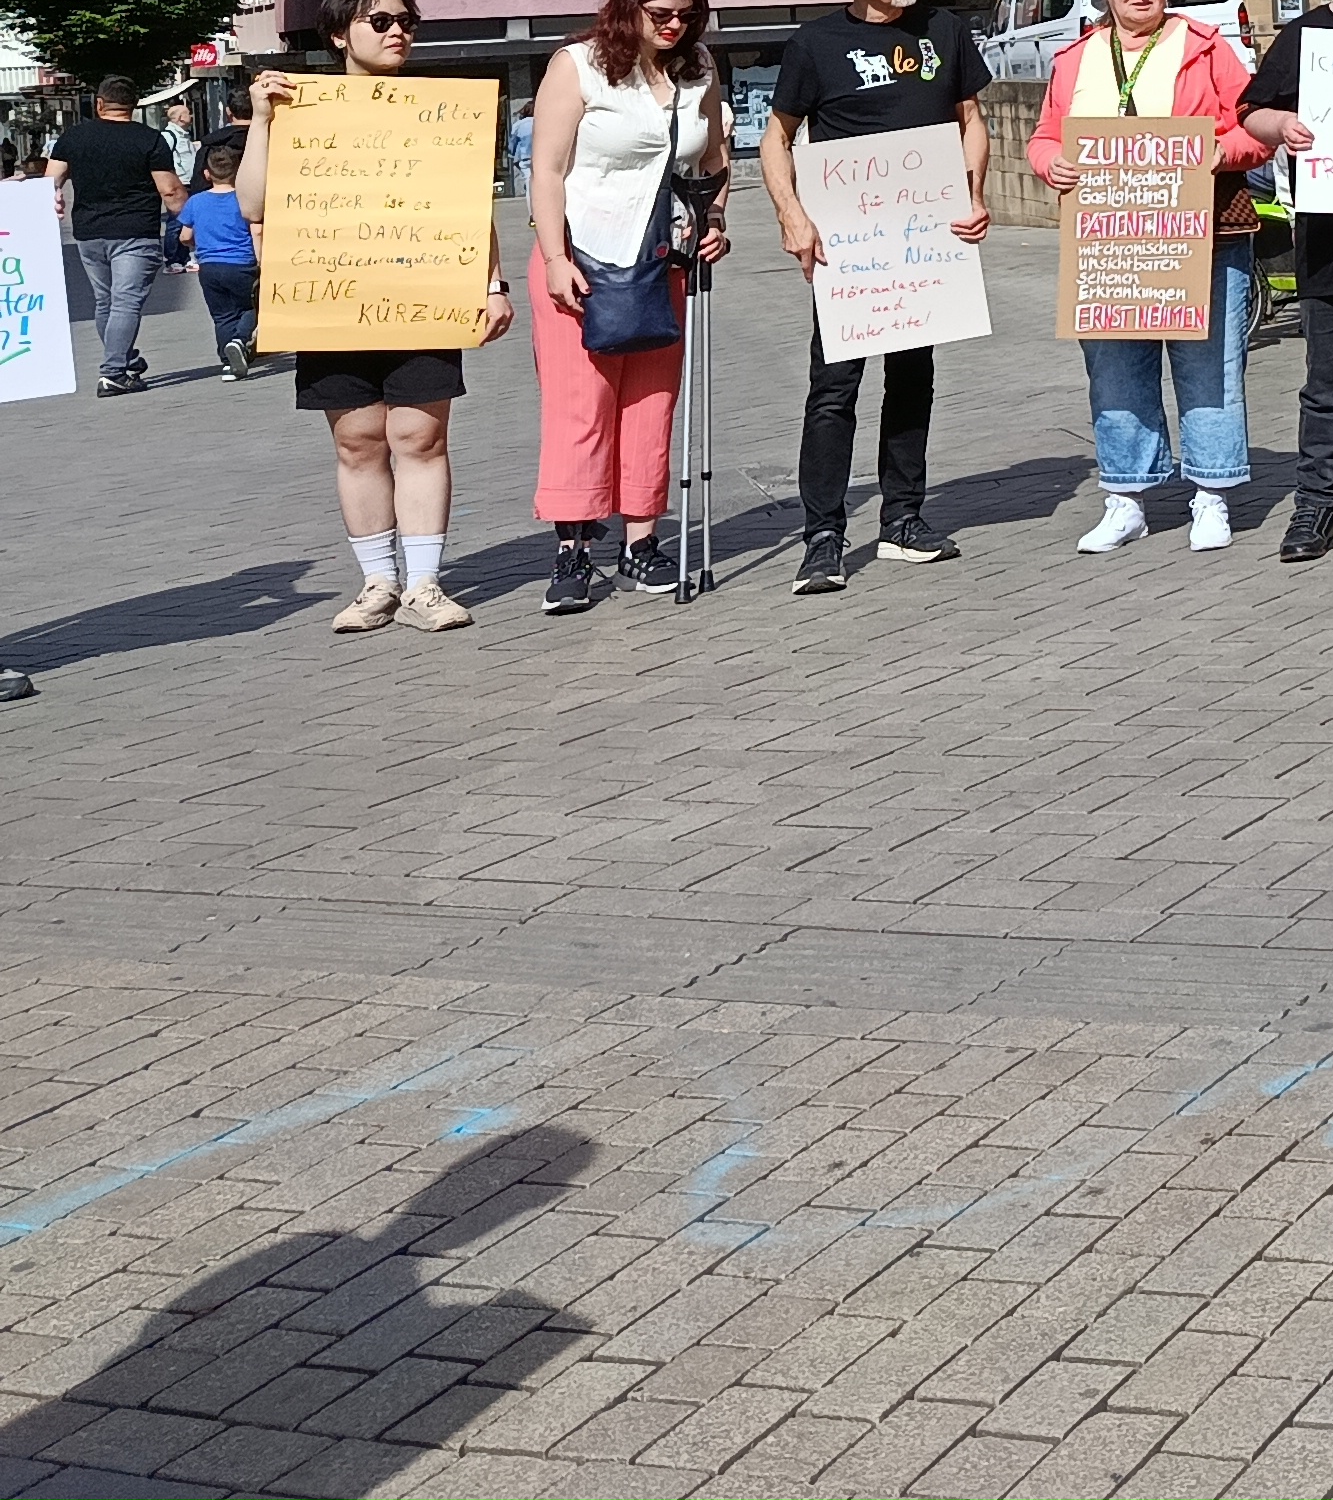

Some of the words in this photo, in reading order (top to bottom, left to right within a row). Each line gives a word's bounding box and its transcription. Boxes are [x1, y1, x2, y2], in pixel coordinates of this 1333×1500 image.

[194, 48, 216, 65] illy
[894, 45, 919, 74] le
[289, 81, 350, 109] Ich
[418, 101, 486, 123] aktiv
[292, 133, 338, 150] und
[352, 129, 393, 150] will
[403, 137, 419, 149] es
[432, 131, 475, 147] auch
[1077, 131, 1204, 167] ZUHÖREN
[1077, 169, 1113, 187] statt
[1119, 166, 1184, 188] Medical
[286, 192, 365, 218] Möglich
[383, 193, 406, 210] ist
[413, 200, 432, 211] es
[857, 192, 885, 215] für
[896, 185, 954, 205] ALLE
[1078, 184, 1180, 208] Gaslighting!
[296, 226, 344, 241] nur
[358, 221, 425, 243] DANK
[828, 222, 886, 248] auch
[903, 213, 948, 242] für
[290, 248, 452, 273] Eingliederungshilfe
[838, 256, 895, 274] taube
[904, 245, 970, 265] Nüsse
[1078, 240, 1103, 257] mit
[1078, 255, 1183, 272] unsichtbaren
[271, 279, 357, 304] KEINE
[831, 277, 946, 300] Höranlagen
[1077, 283, 1187, 305] Erkrankungen
[357, 297, 486, 334] KÜRZUNG!
[872, 296, 907, 313] und
[1075, 302, 1136, 333] ERNST
[1135, 302, 1209, 331] NEHMEN
